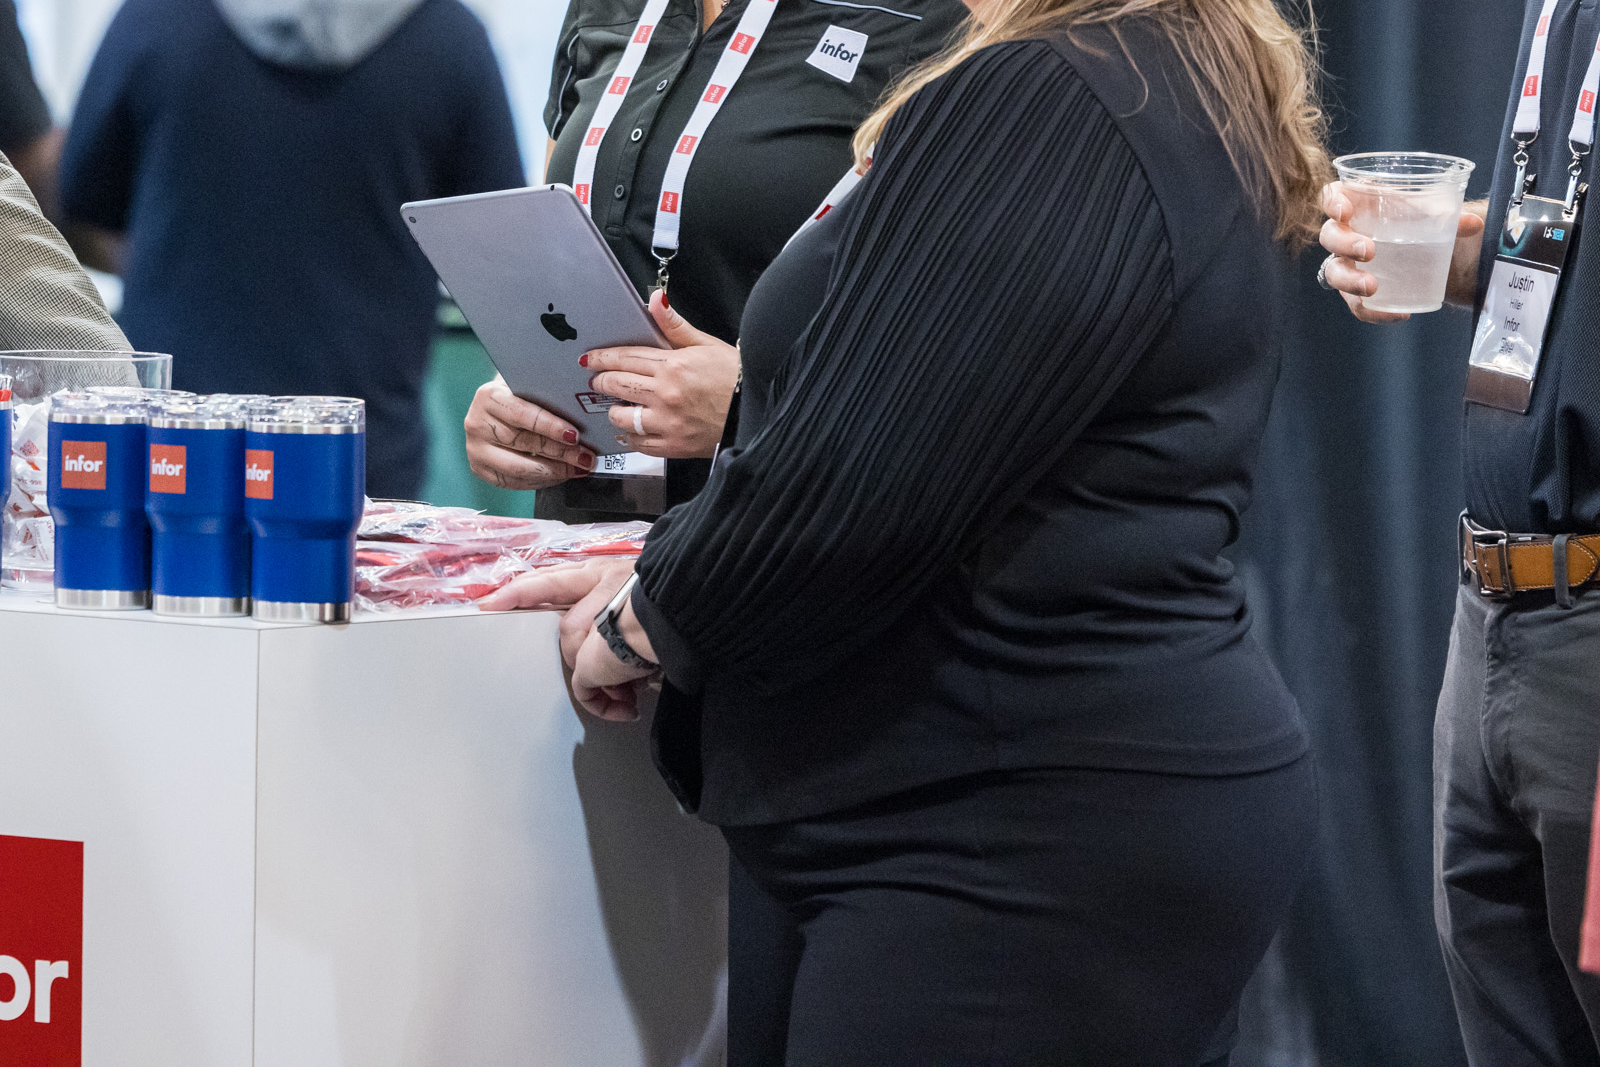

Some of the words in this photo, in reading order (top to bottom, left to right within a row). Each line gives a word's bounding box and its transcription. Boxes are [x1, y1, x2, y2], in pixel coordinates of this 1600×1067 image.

[737, 34, 749, 52] infor
[819, 39, 858, 64] infor
[708, 85, 721, 102] infor
[681, 136, 693, 153] infor
[665, 193, 674, 212] infor
[1508, 271, 1535, 293] Justin
[1503, 316, 1520, 332] Infor
[64, 454, 104, 473] infor
[151, 458, 184, 477] infor
[245, 463, 272, 482] infor
